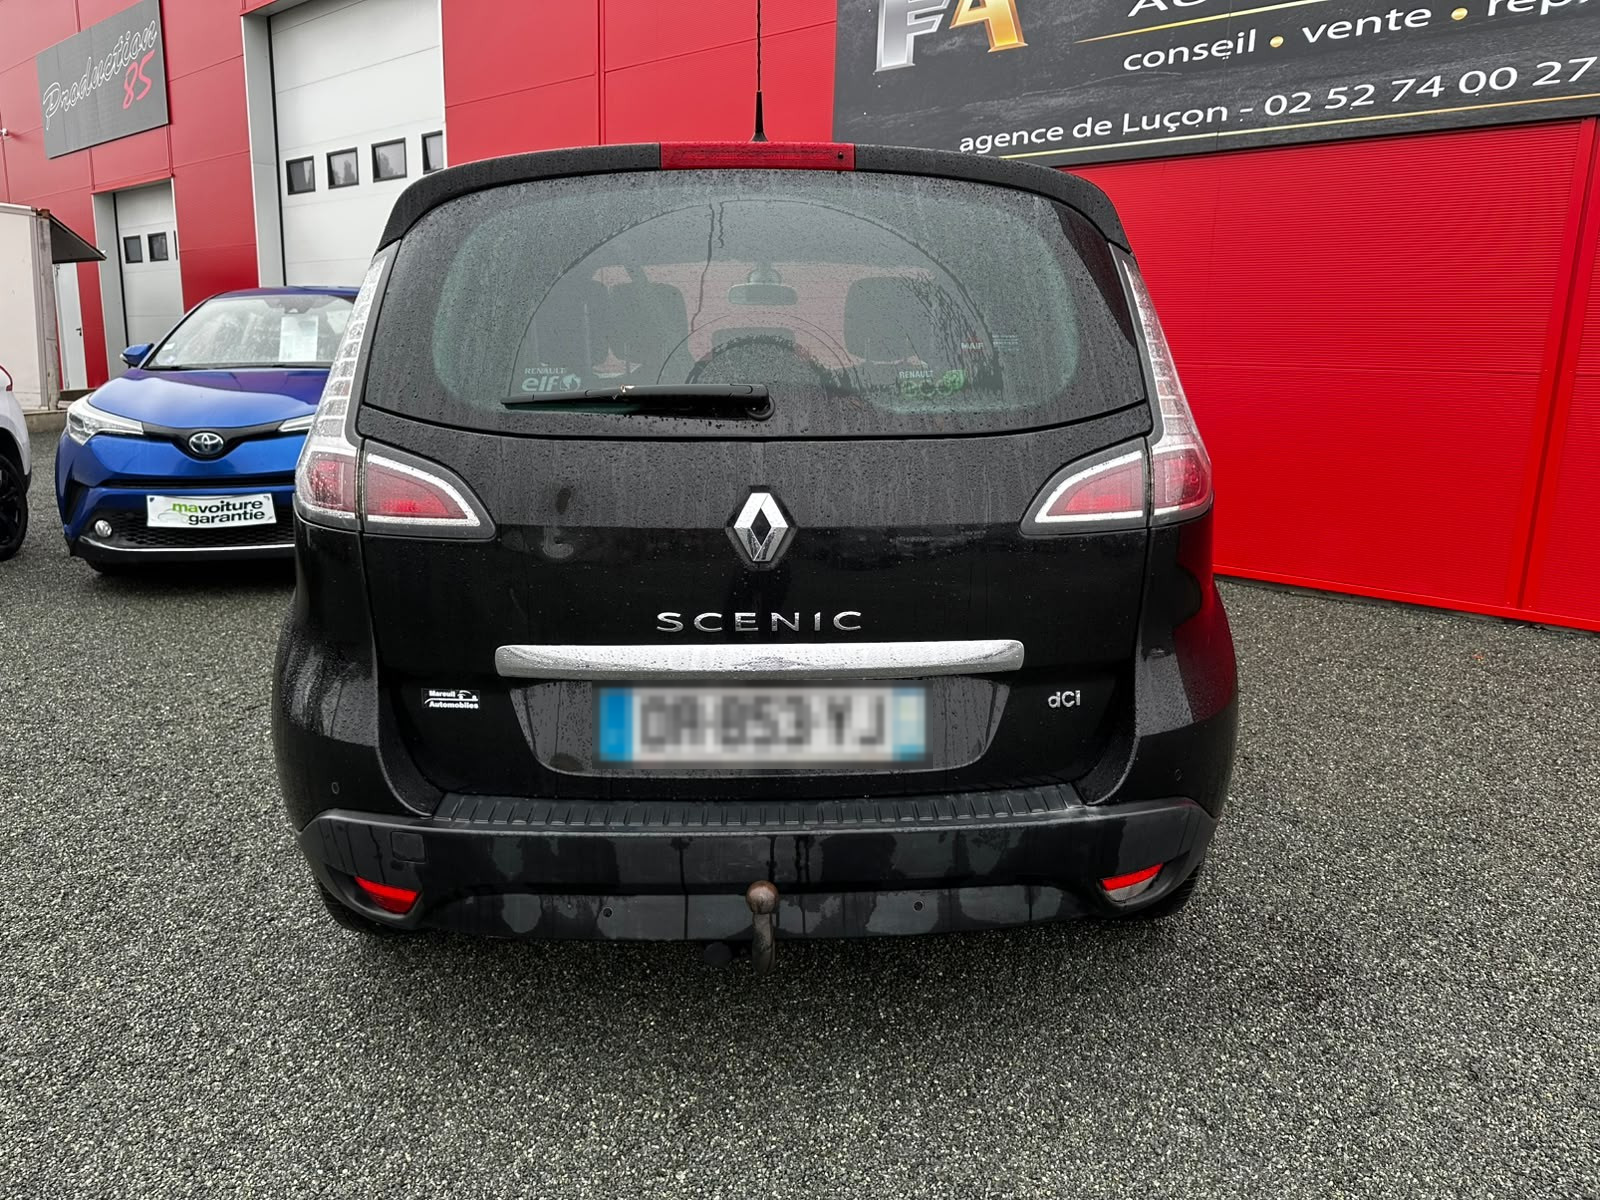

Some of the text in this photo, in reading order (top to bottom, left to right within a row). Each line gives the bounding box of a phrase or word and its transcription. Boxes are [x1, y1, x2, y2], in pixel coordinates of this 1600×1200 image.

[1123, 0, 1590, 71] conseil vente rep
[43, 20, 158, 131] Production
[122, 49, 155, 110] 85
[959, 126, 1064, 154] agence
[1072, 117, 1113, 139] de
[1122, 105, 1228, 135] Luçon
[1264, 91, 1311, 116] 02
[1324, 84, 1376, 110] 52
[1390, 75, 1445, 102] 74
[1458, 66, 1518, 96] 00
[1532, 56, 1598, 87] 27
[524, 367, 566, 375] RENAULT
[898, 369, 934, 379] RENAULT
[521, 375, 560, 392] elf
[172, 500, 263, 514] mavoiture
[188, 509, 265, 526] garantie
[656, 611, 862, 633] SCENIC
[428, 700, 479, 709] Automobiles
